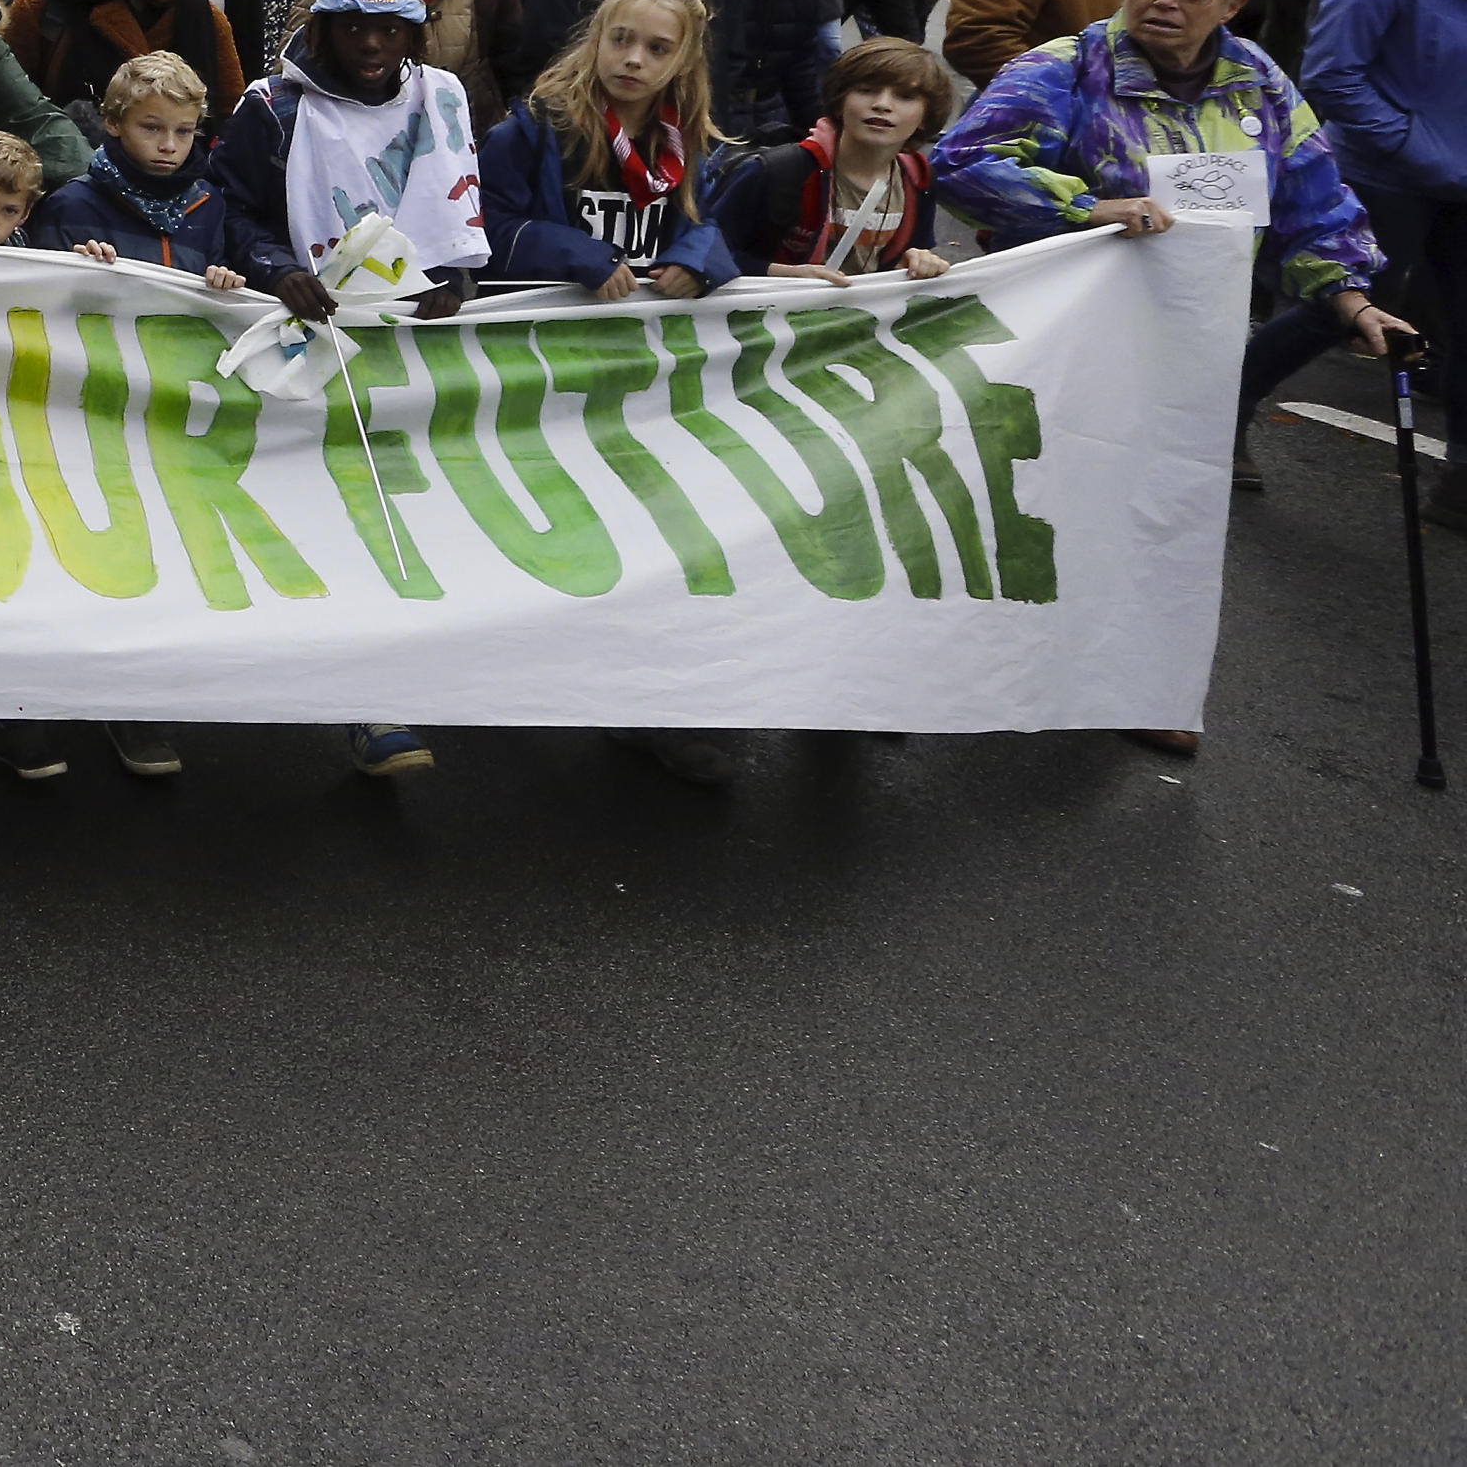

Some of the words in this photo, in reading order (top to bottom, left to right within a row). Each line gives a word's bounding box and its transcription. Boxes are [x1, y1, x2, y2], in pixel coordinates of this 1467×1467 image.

[1166, 155, 1208, 179] WORLD
[1210, 155, 1248, 174] PEACE
[1174, 198, 1186, 209] IS
[323, 294, 1056, 604] FUTURE
